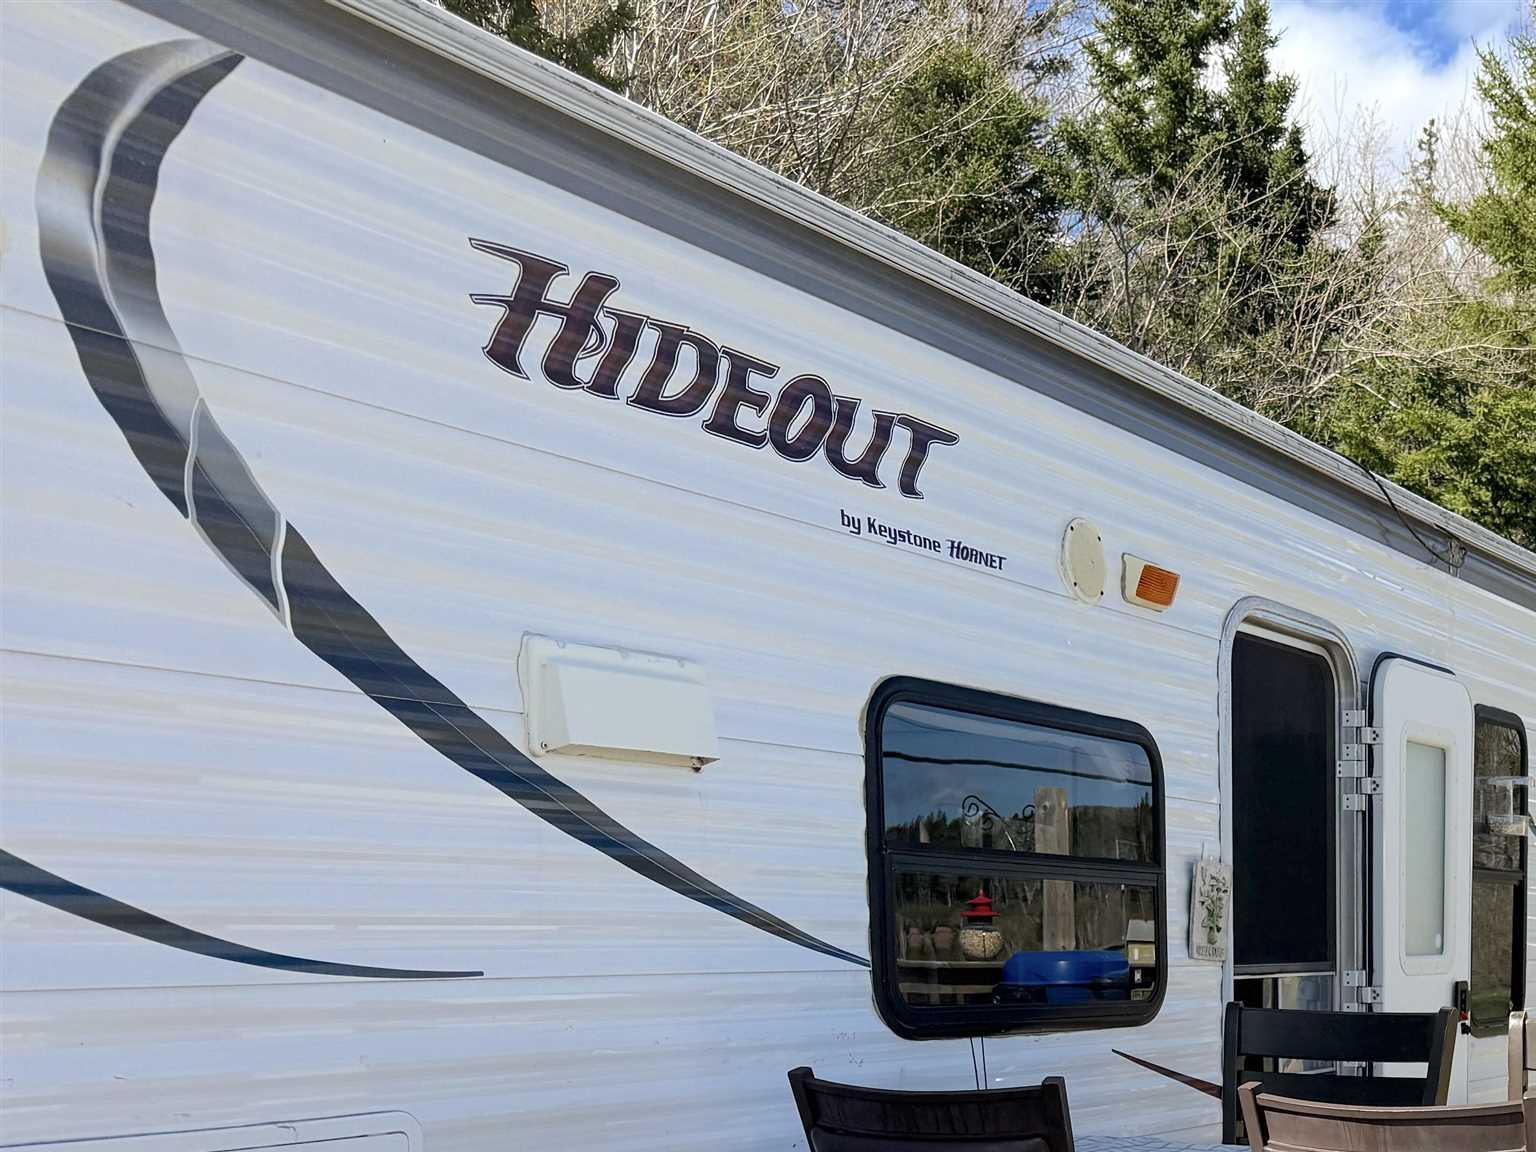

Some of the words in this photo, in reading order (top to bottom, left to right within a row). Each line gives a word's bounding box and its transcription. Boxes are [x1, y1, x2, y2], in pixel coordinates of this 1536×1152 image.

[468, 237, 960, 499] HIDEOUT
[841, 509, 861, 535] by
[867, 516, 941, 553] Keystone
[947, 539, 1007, 570] HORNET
